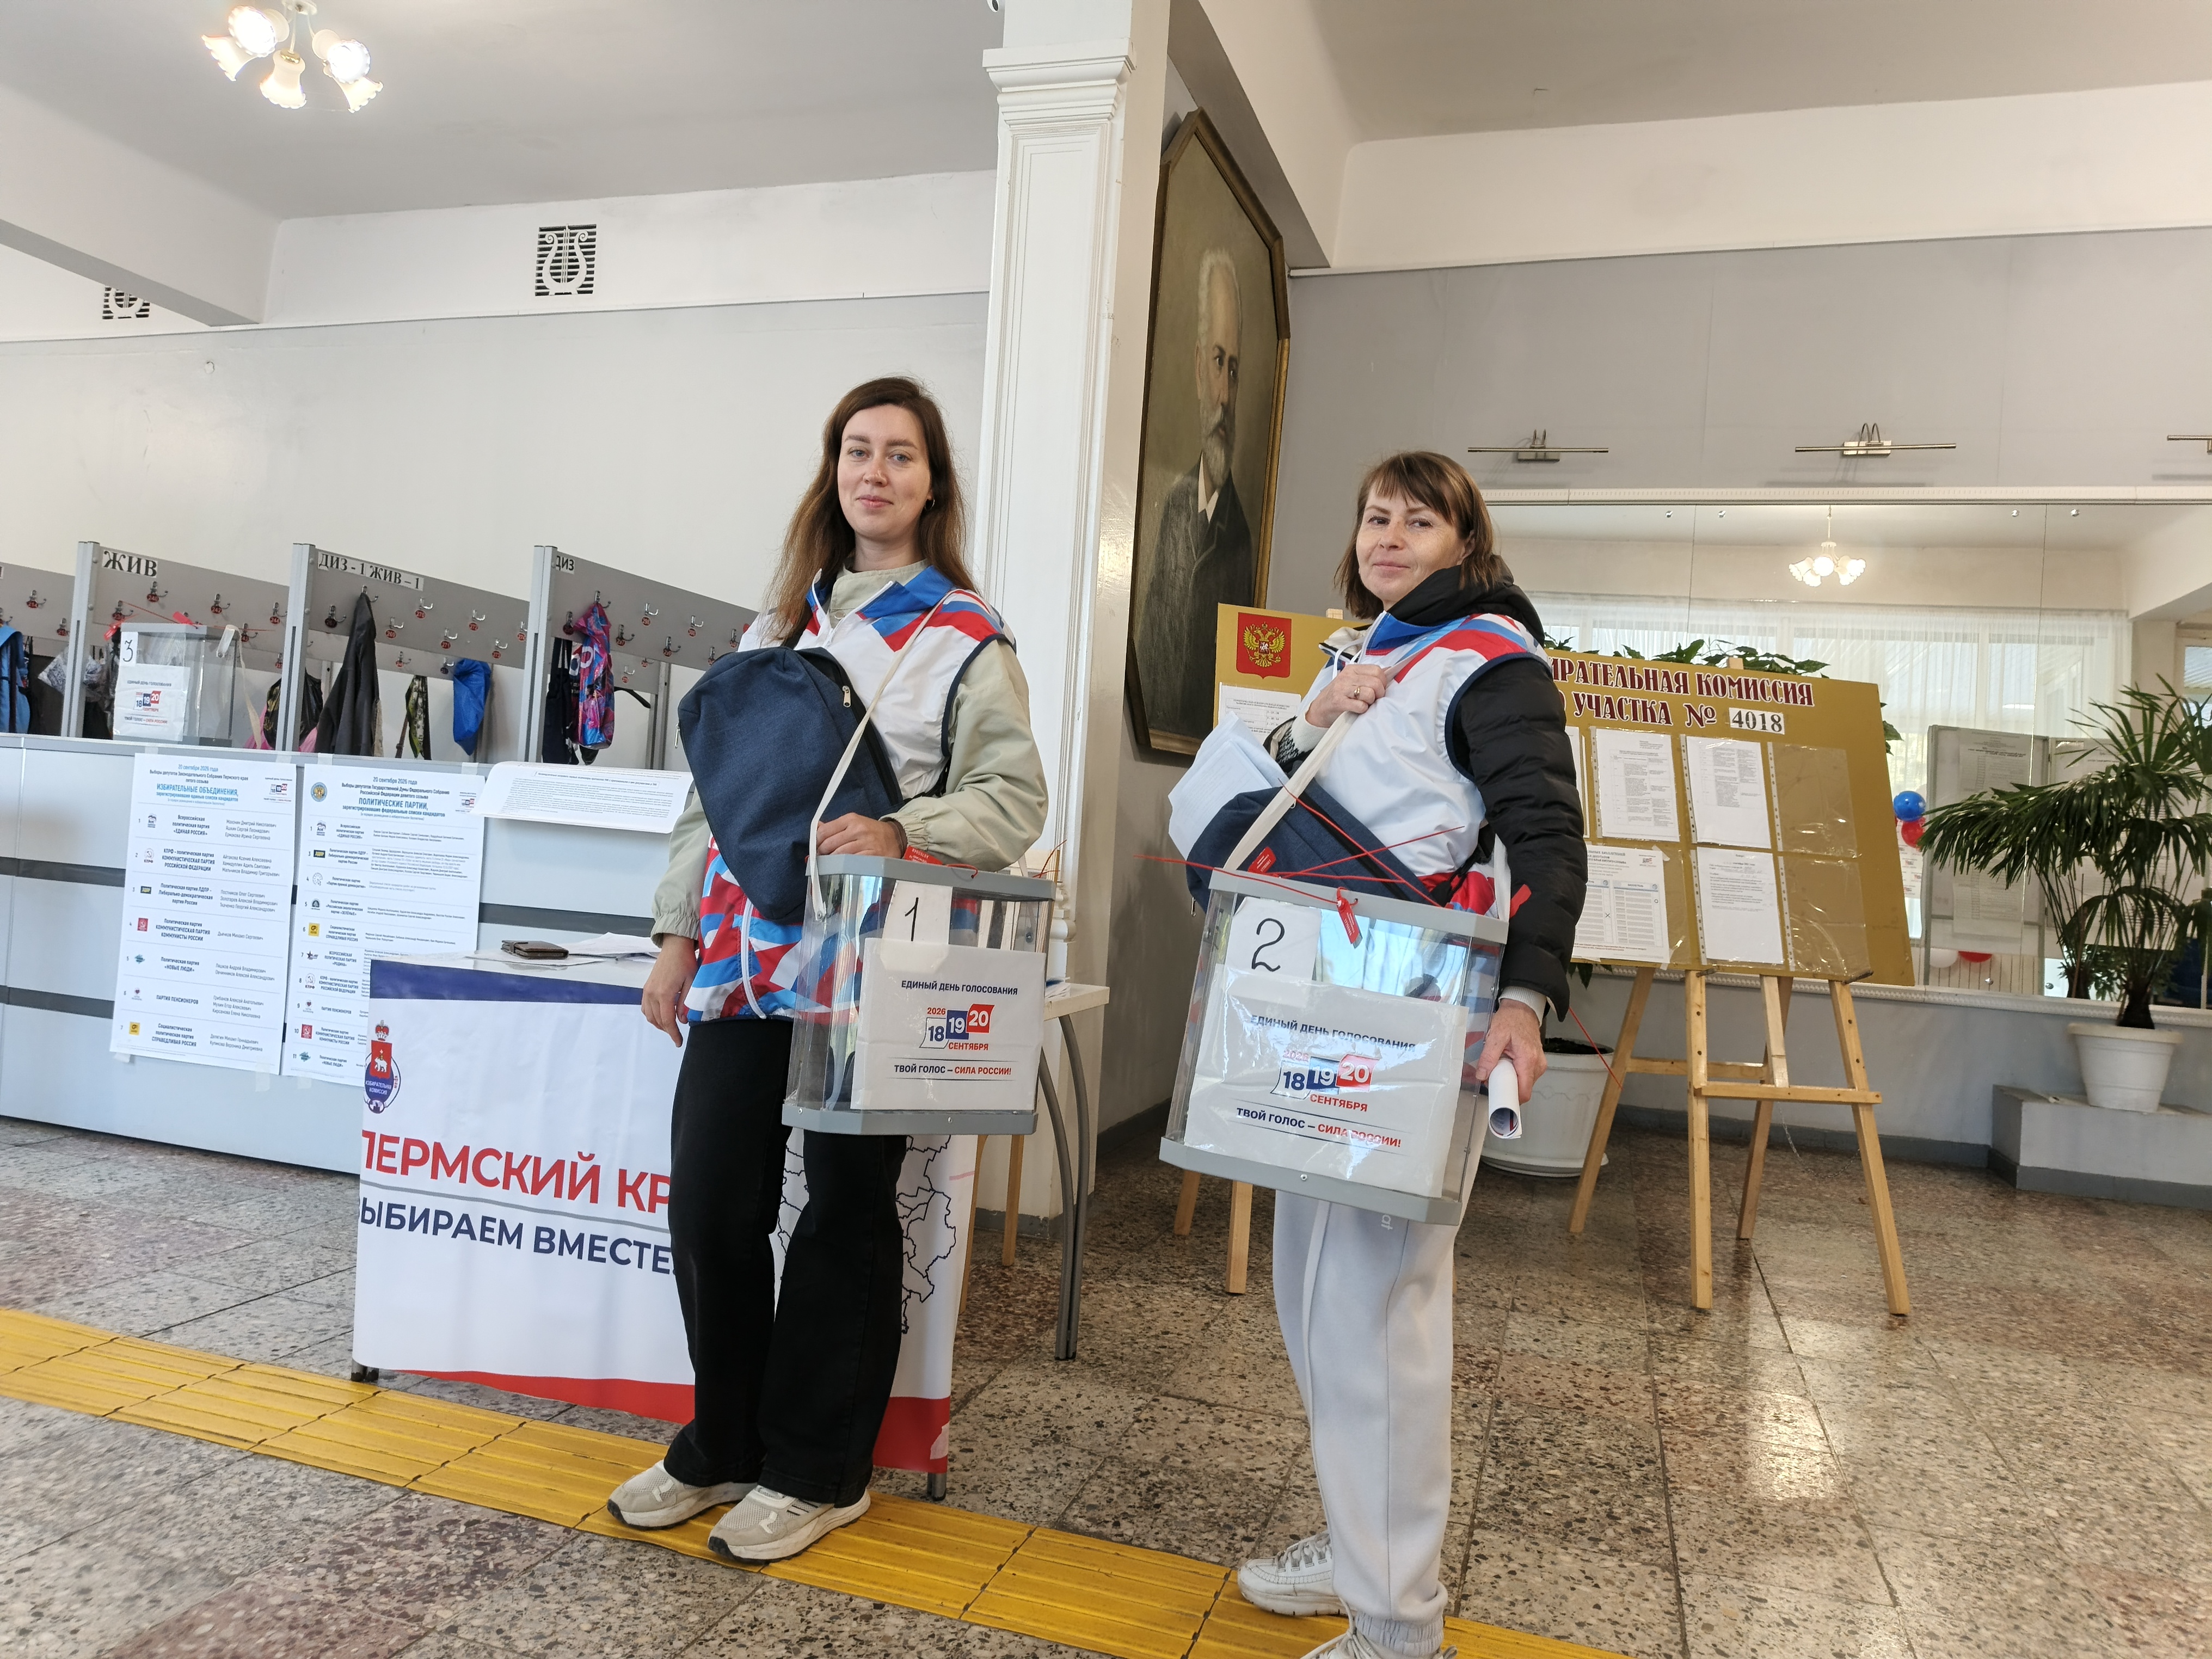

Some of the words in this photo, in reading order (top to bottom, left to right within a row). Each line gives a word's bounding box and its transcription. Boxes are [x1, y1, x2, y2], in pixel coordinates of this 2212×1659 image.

[103, 551, 157, 577] ЖИВ
[319, 554, 347, 570] ДИЗ
[361, 563, 364, 574] 1
[370, 565, 401, 584] ЖИВ
[415, 578, 419, 589] 1
[556, 556, 574, 570] ДИЗ
[123, 640, 133, 662] 3
[1550, 656, 1689, 695] ИРАТЕЛЬНАЯ
[1697, 673, 1814, 706] КОМИССИЯ
[1573, 691, 1673, 726] УЧАСТКА
[1685, 703, 1716, 728] №
[1732, 710, 1783, 733] 4018
[157, 783, 198, 792] ИЗБИРАТЕЛЬНЫЕ
[199, 787, 238, 796] ОБЪЕДИНЕНИЯ,
[359, 798, 403, 808] ПОЛИТИЧЕСКИЕ
[405, 801, 428, 811] ПАРТИИ,
[905, 897, 919, 942] 1
[1251, 918, 1285, 972] 2
[901, 980, 937, 991] ЕДИНЫЙ
[939, 983, 960, 992] ДЕНЬ
[962, 985, 1018, 996] ГОЛОСОВАНИЯ
[928, 1026, 944, 1042] 18
[949, 1017, 965, 1033] 19
[969, 1010, 988, 1027] 20
[1251, 1015, 1298, 1030] ЕДИНЫЙ
[1300, 1024, 1329, 1035] ДЕНЬ
[1332, 1030, 1416, 1052] ГОЛОСОВАНИЯ
[949, 1042, 988, 1050] СЕНТЯБРЯ
[894, 1064, 917, 1073] ТВОЙ
[919, 1066, 945, 1074] ГОЛОС
[954, 1066, 976, 1074] СИЛА
[978, 1067, 1011, 1075] РОССИИ!
[1283, 1072, 1305, 1090] 18
[1312, 1066, 1334, 1085] 19
[1341, 1062, 1369, 1083] 20
[1310, 1094, 1368, 1111] СЕНТЯБРЯ
[1237, 1107, 1266, 1122] ТВОЙ
[1269, 1114, 1305, 1128] ГОЛОС
[1318, 1124, 1348, 1137] СИЛА
[1350, 1130, 1401, 1147] РОССИИ!
[361, 1197, 523, 1250] ЫБИРАЕМ
